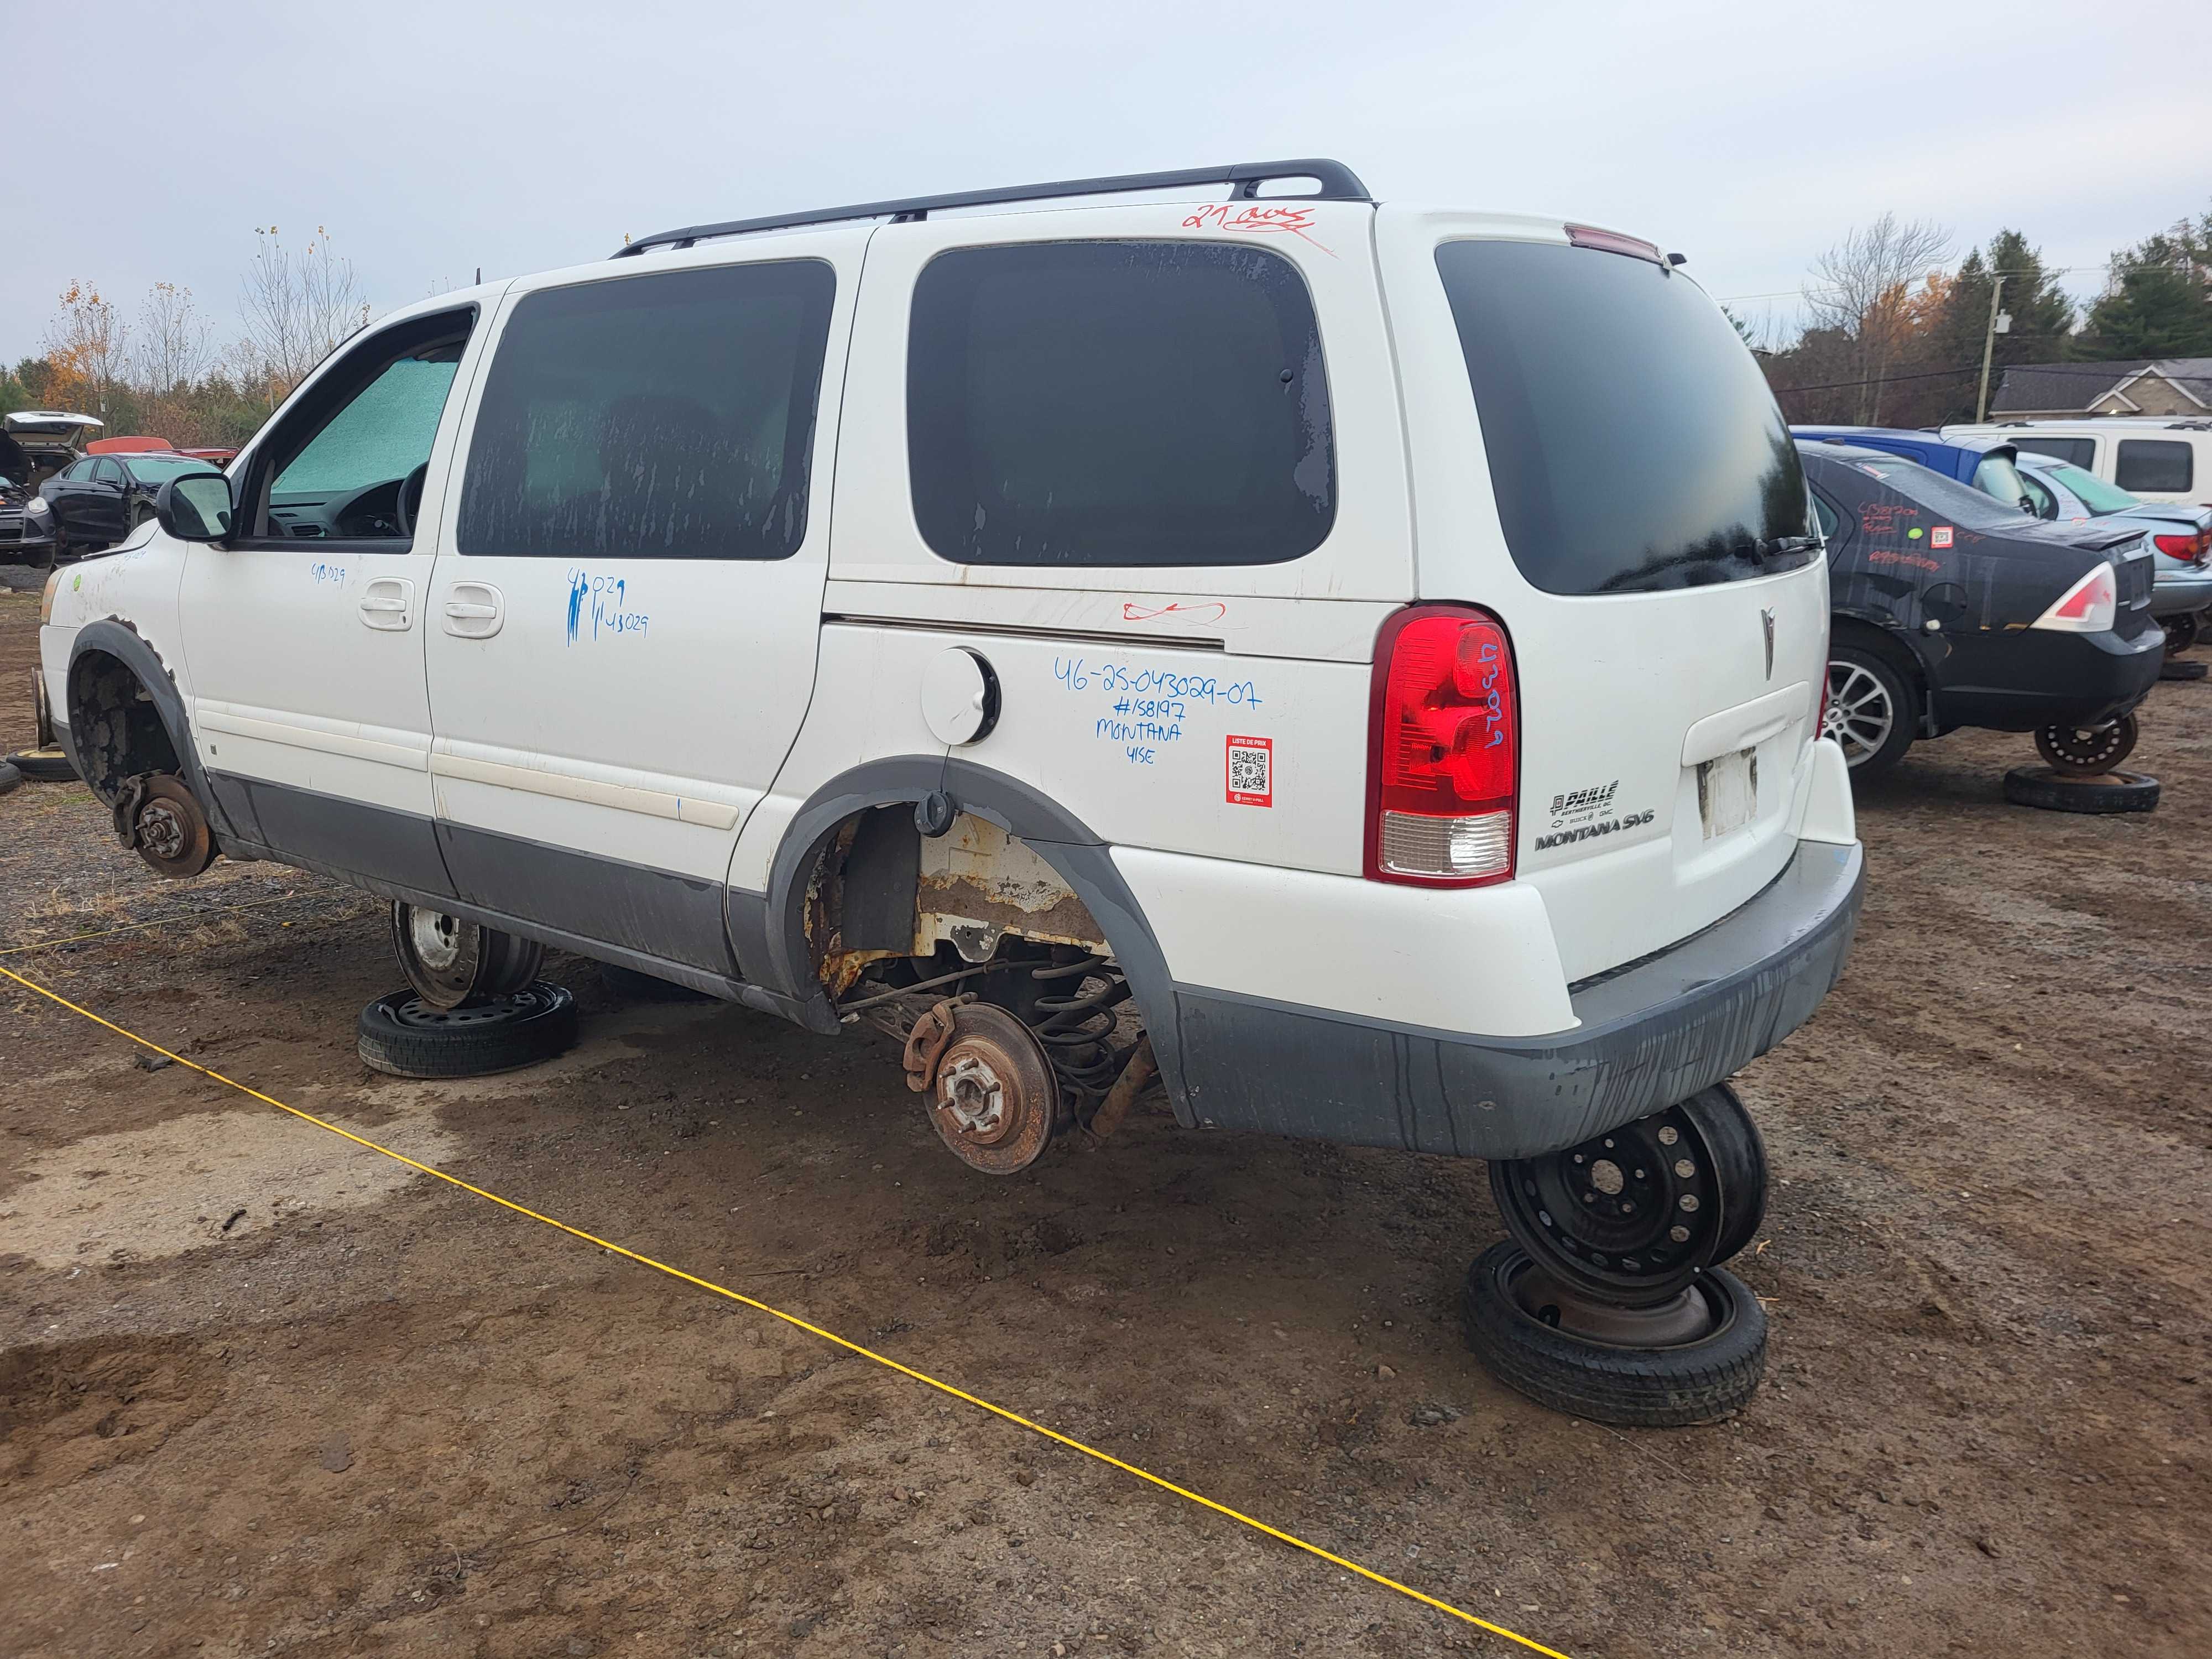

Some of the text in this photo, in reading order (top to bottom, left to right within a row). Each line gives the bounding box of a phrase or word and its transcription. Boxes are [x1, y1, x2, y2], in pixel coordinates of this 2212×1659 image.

[606, 613, 649, 639] 43029
[1113, 696, 1186, 722] #158197
[1478, 643, 1504, 749] 43029
[1097, 718, 1182, 742] MONTANA
[1535, 809, 1655, 851] MONTANA SV6
